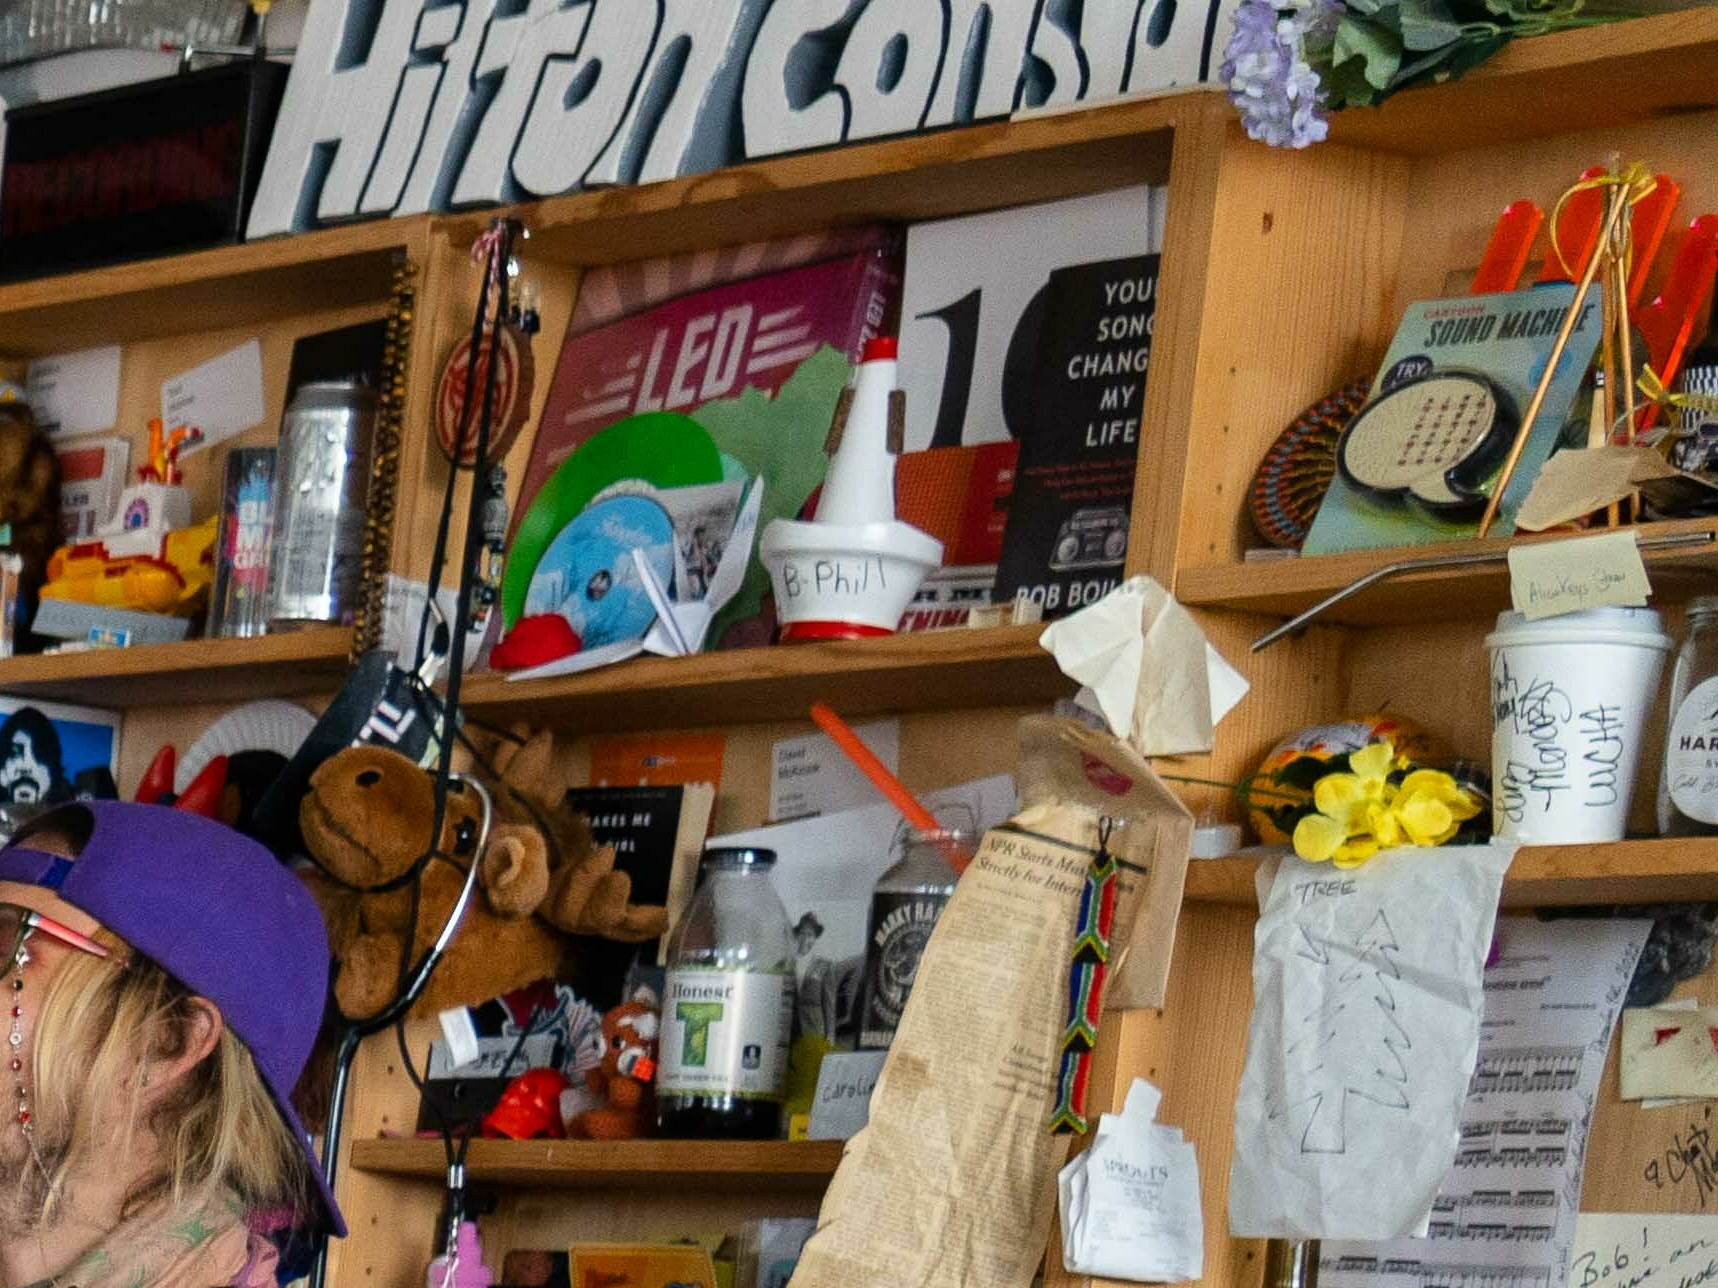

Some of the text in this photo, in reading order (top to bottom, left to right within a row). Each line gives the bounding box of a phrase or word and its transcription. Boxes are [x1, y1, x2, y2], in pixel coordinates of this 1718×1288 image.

[1424, 314, 1496, 348] SOUND
[1396, 361, 1428, 379] TRY
[1100, 385, 1137, 411] MY
[1085, 420, 1137, 447] LIFE
[987, 838, 1053, 869] NPR Starts
[977, 856, 1026, 887] Strictly
[1295, 879, 1358, 904] TREE
[671, 982, 732, 999] Honest
[676, 1002, 724, 1066] T
